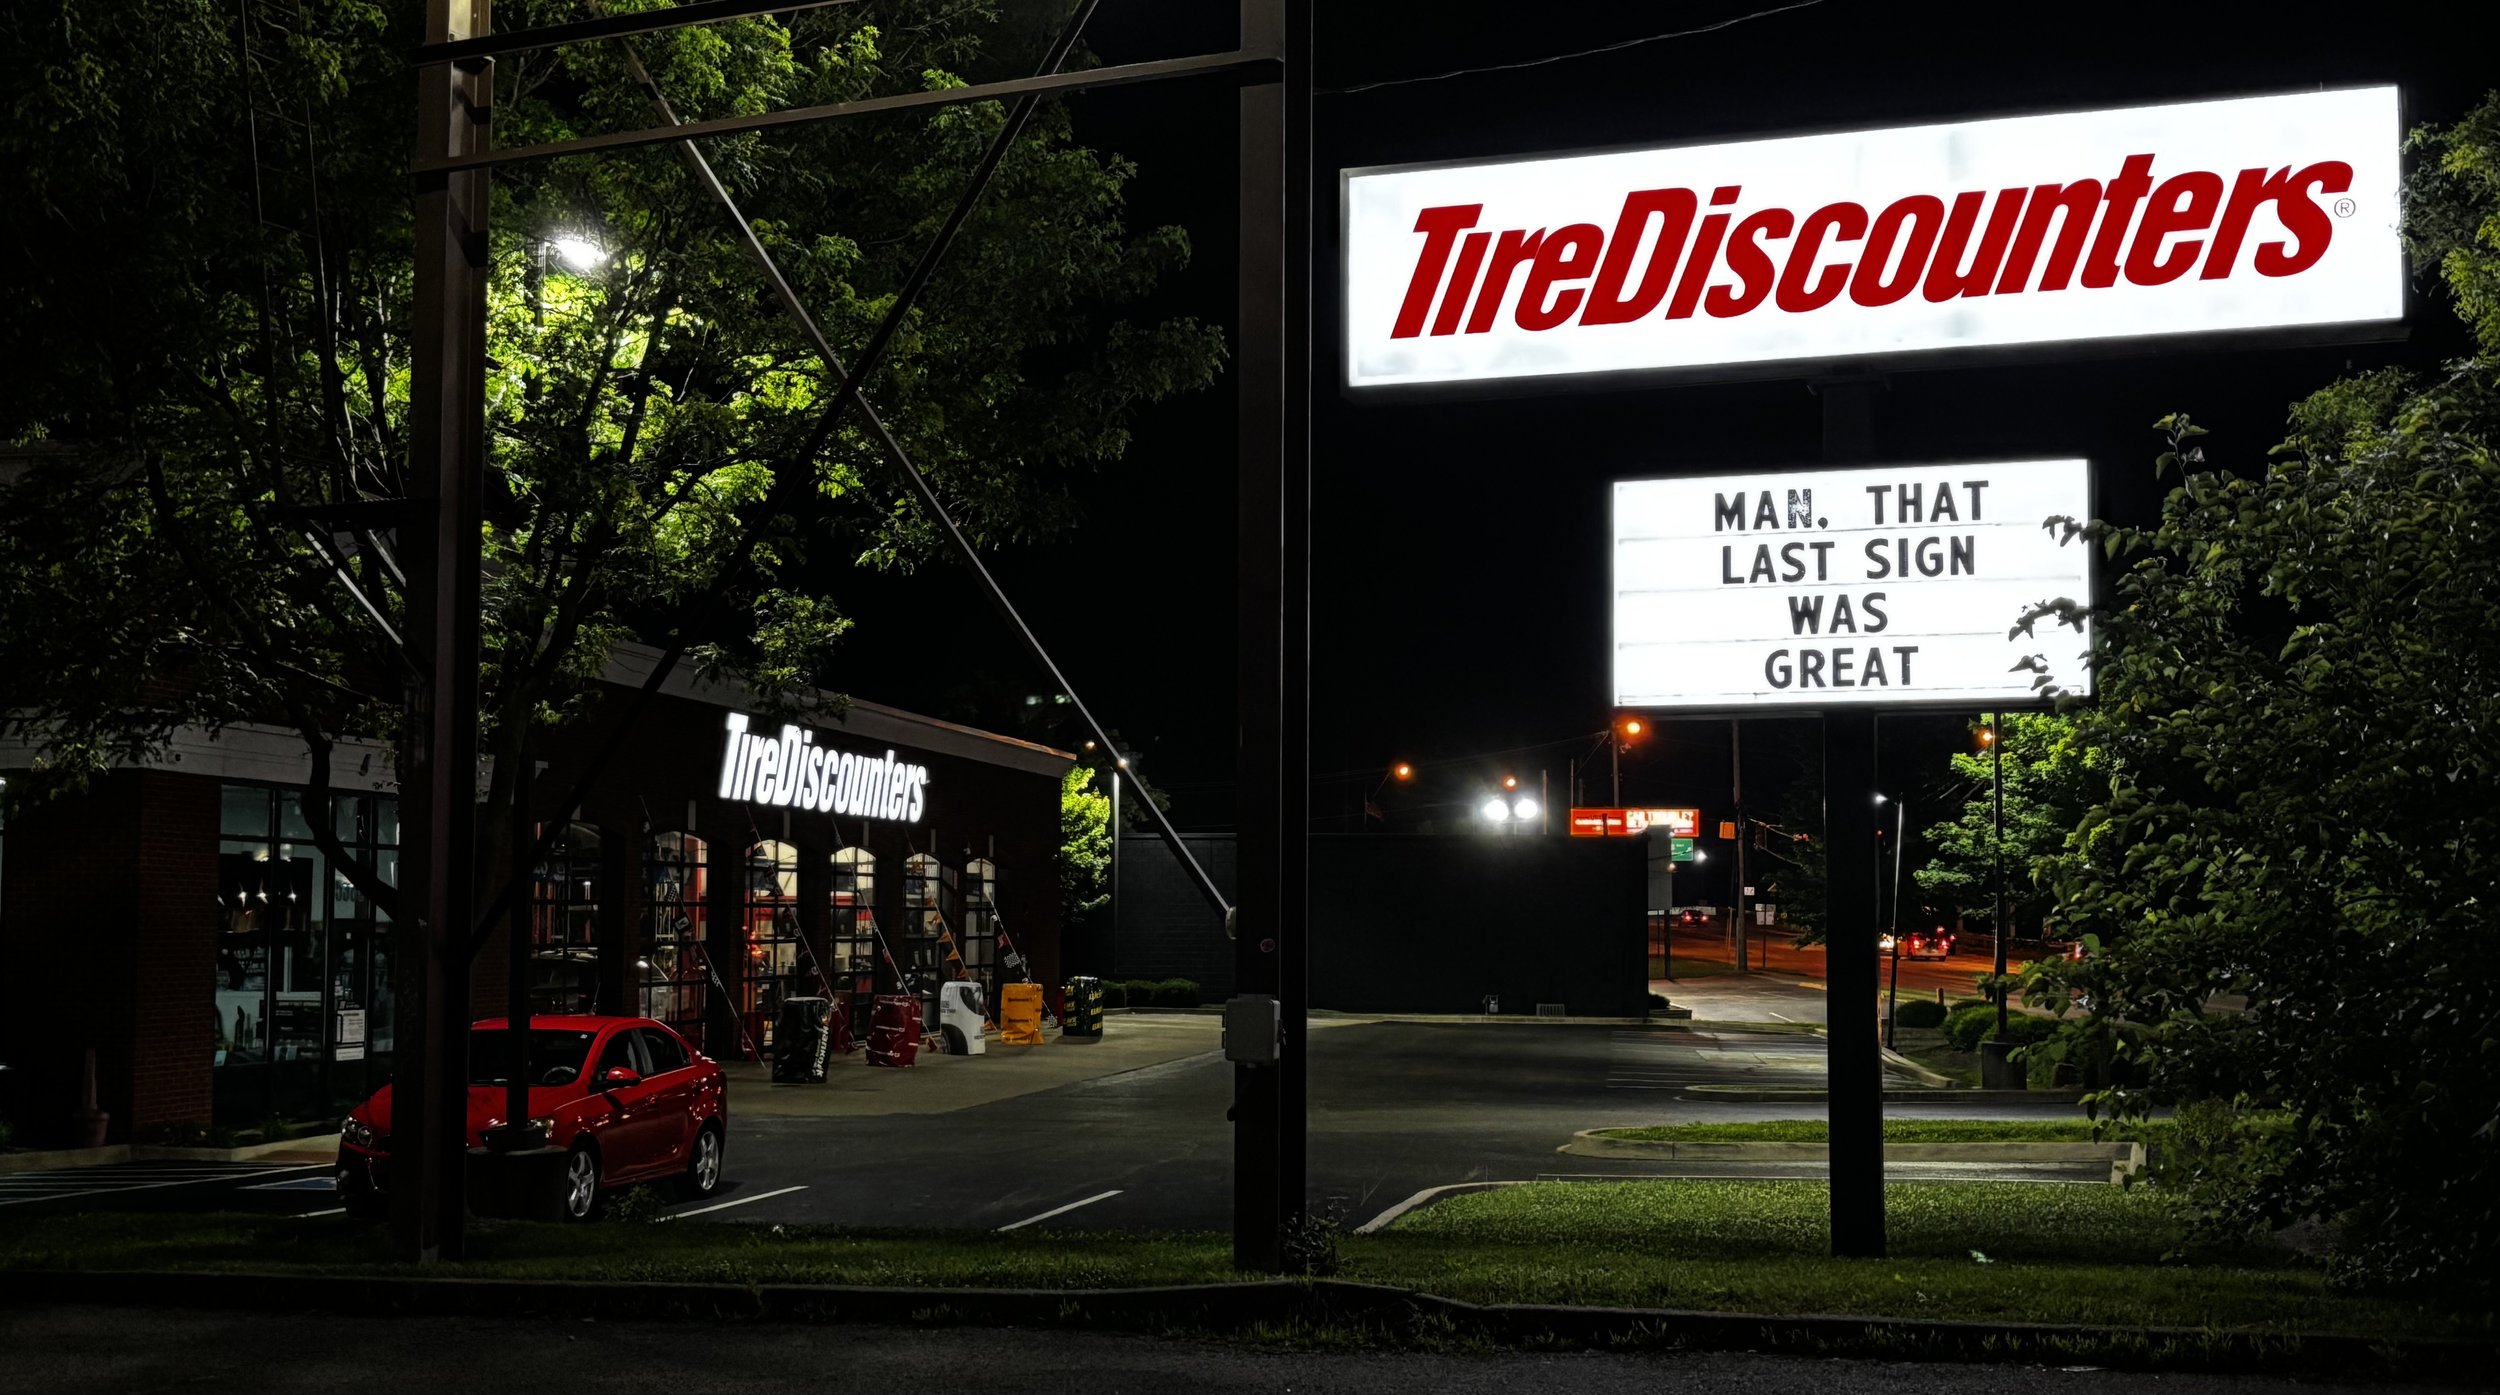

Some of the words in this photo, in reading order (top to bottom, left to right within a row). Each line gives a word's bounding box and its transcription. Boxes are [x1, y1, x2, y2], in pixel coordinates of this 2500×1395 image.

[1714, 488, 1829, 532] MAN,
[1865, 480, 1989, 525] THAT
[1722, 541, 1835, 585] LAST
[1864, 535, 1976, 580] SIGN
[1787, 592, 1889, 635] WAS
[1764, 645, 1919, 690] GREAT
